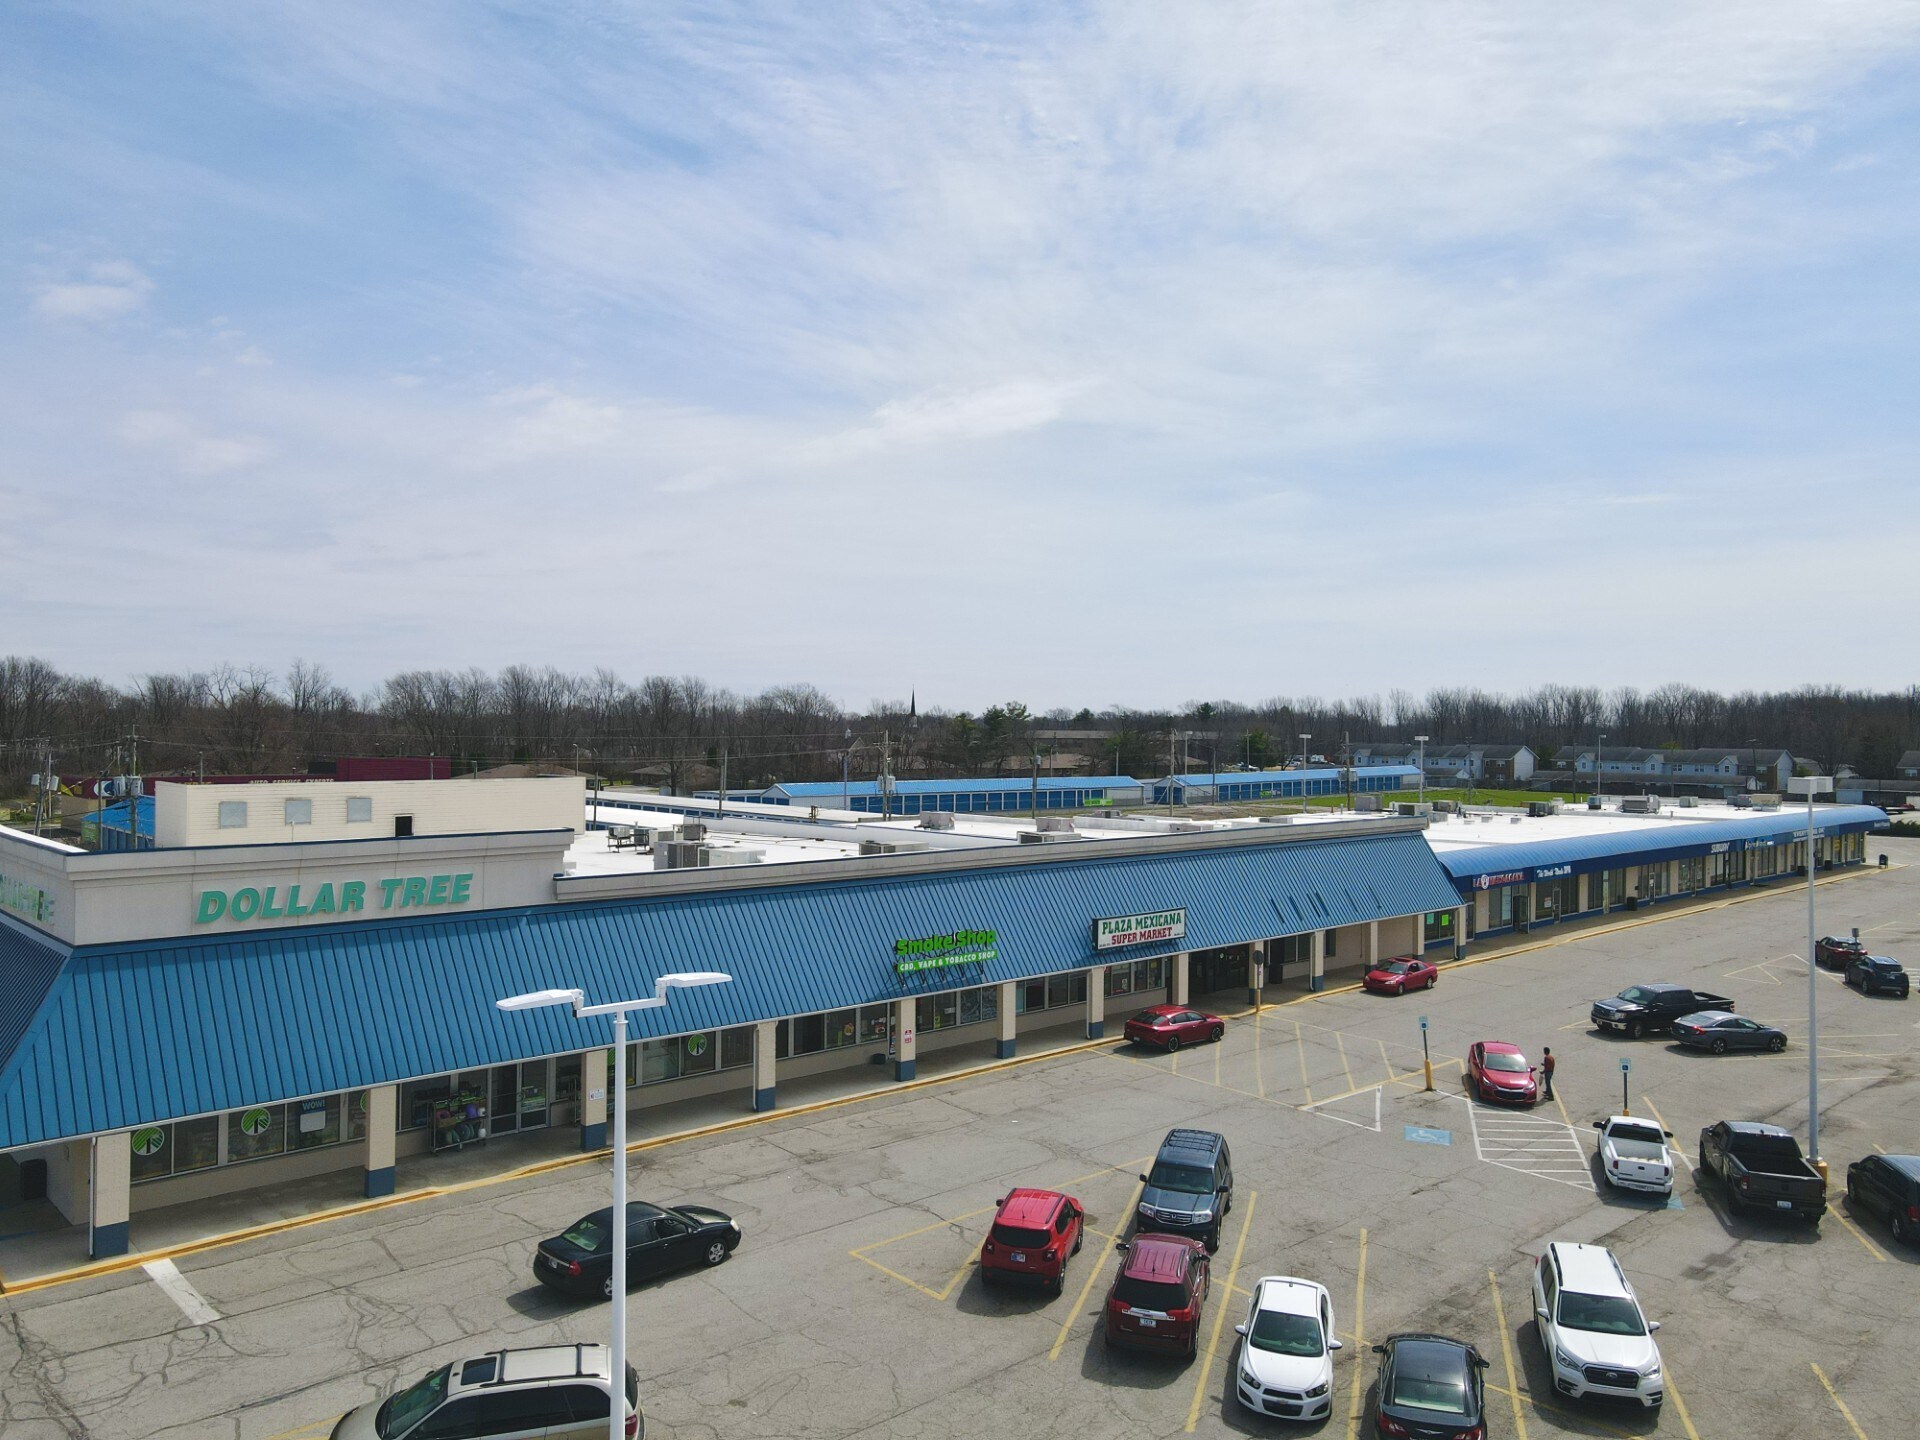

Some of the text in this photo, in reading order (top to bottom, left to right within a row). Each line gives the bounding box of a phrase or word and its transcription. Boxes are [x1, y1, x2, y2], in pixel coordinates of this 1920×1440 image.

[195, 873, 473, 923] DOLLAR TREE
[1102, 912, 1182, 935] PLAZA MEXICANA
[897, 929, 997, 956] Smoke Shop
[1111, 932, 1138, 945] SUPER
[1139, 926, 1173, 941] MARKET
[900, 962, 916, 971] CBD,
[918, 960, 936, 968] VAPE
[945, 953, 977, 964] TOBACCO
[978, 950, 996, 960] SHOP
[302, 1099, 326, 1111] WOW!
